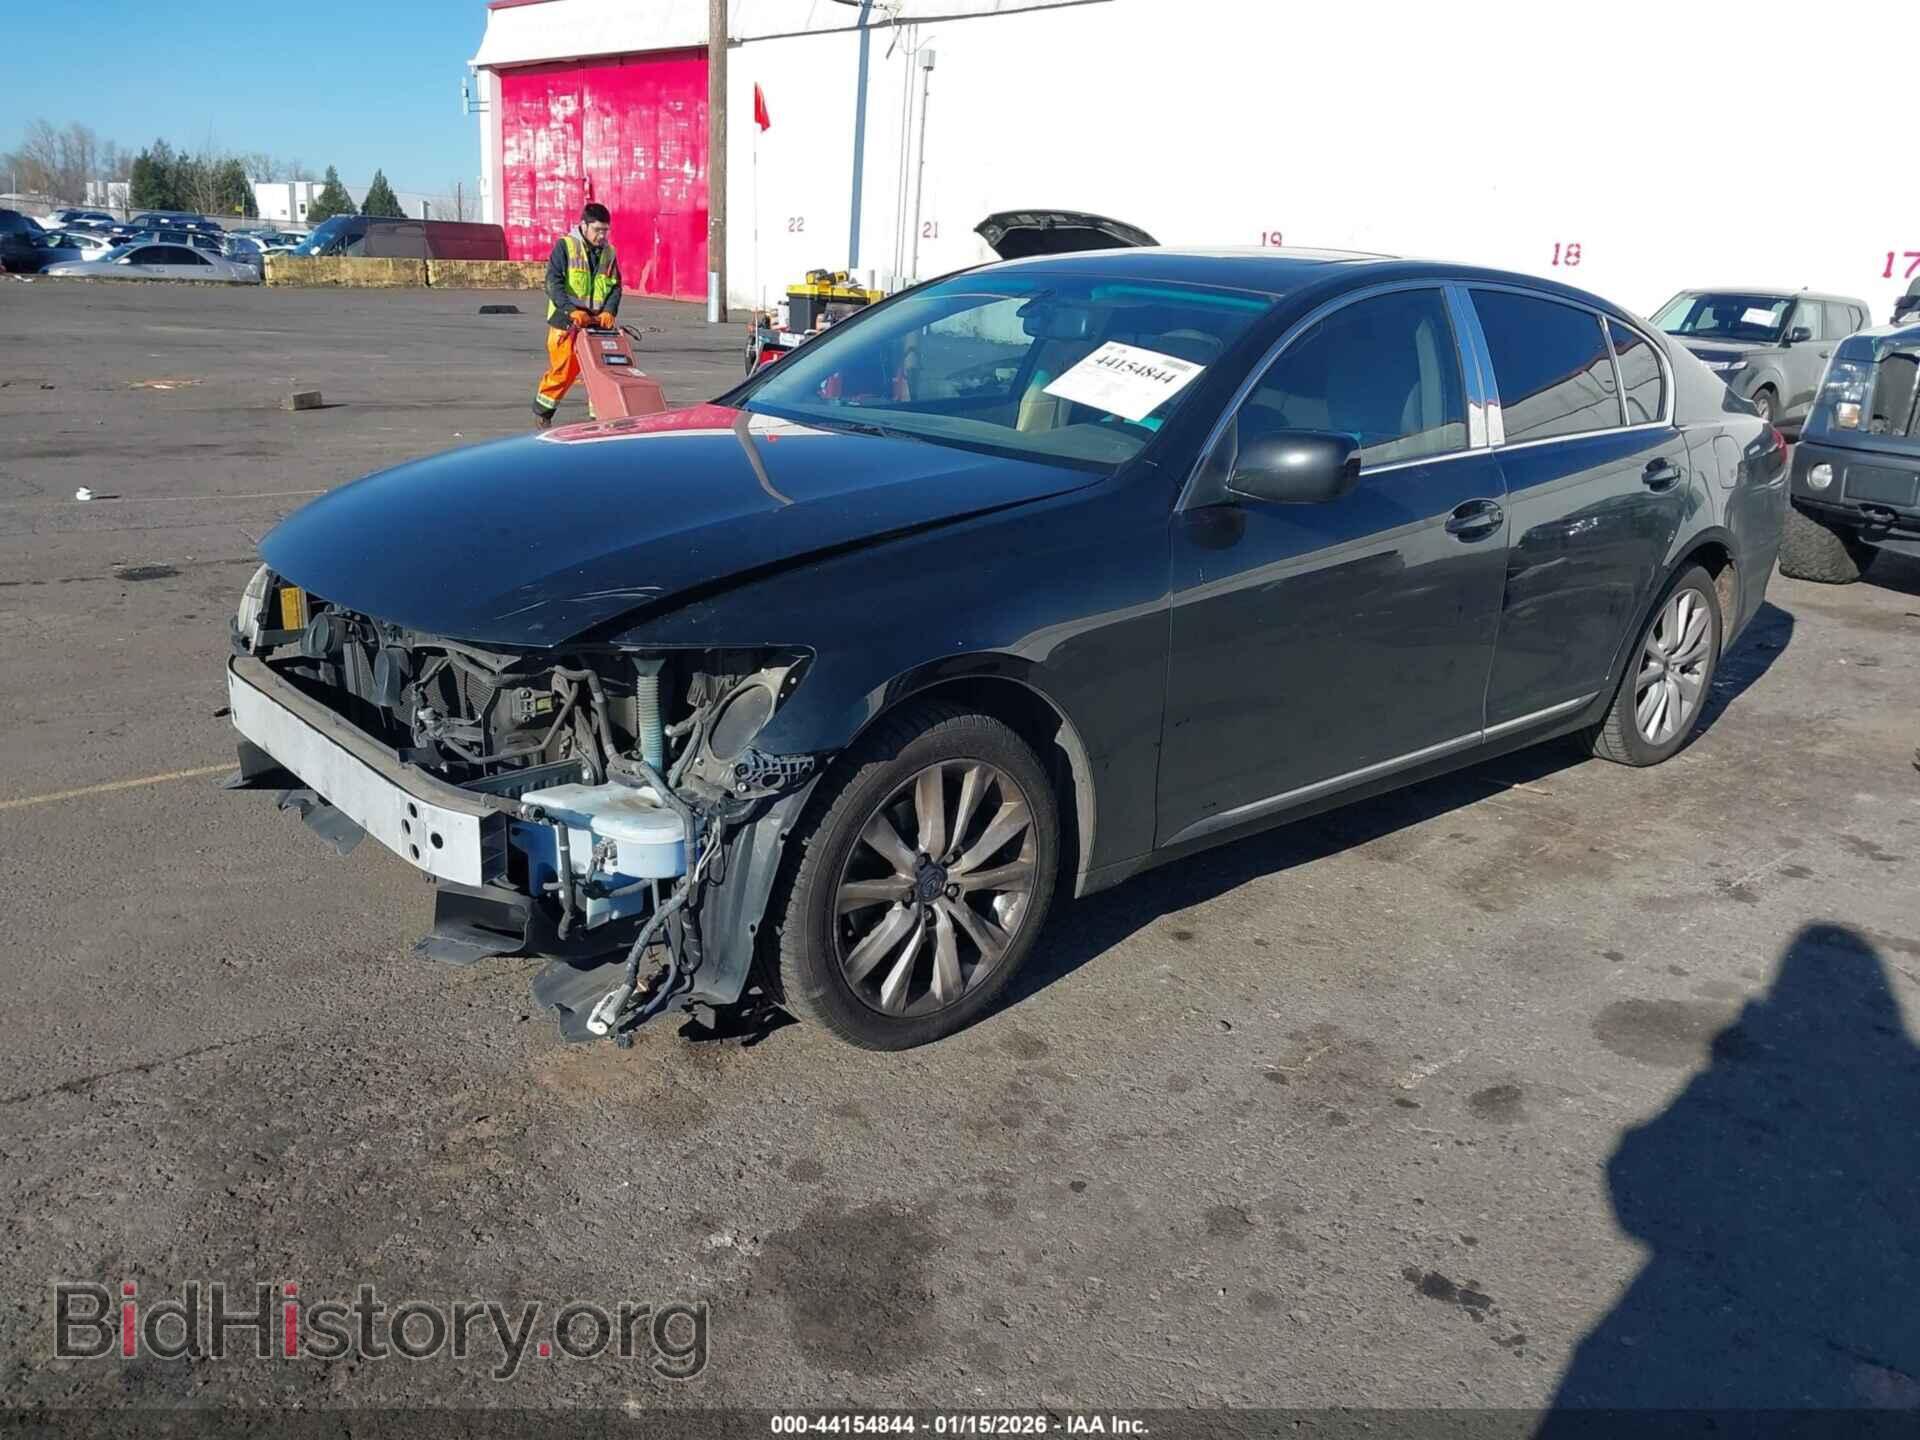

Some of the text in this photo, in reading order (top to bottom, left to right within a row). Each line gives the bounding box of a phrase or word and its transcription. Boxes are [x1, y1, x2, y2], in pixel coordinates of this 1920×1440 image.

[788, 217, 805, 232] 22
[922, 221, 939, 239] 21
[1552, 243, 1581, 266] 18
[1882, 251, 1920, 279] 17
[1096, 355, 1178, 384] 44154844
